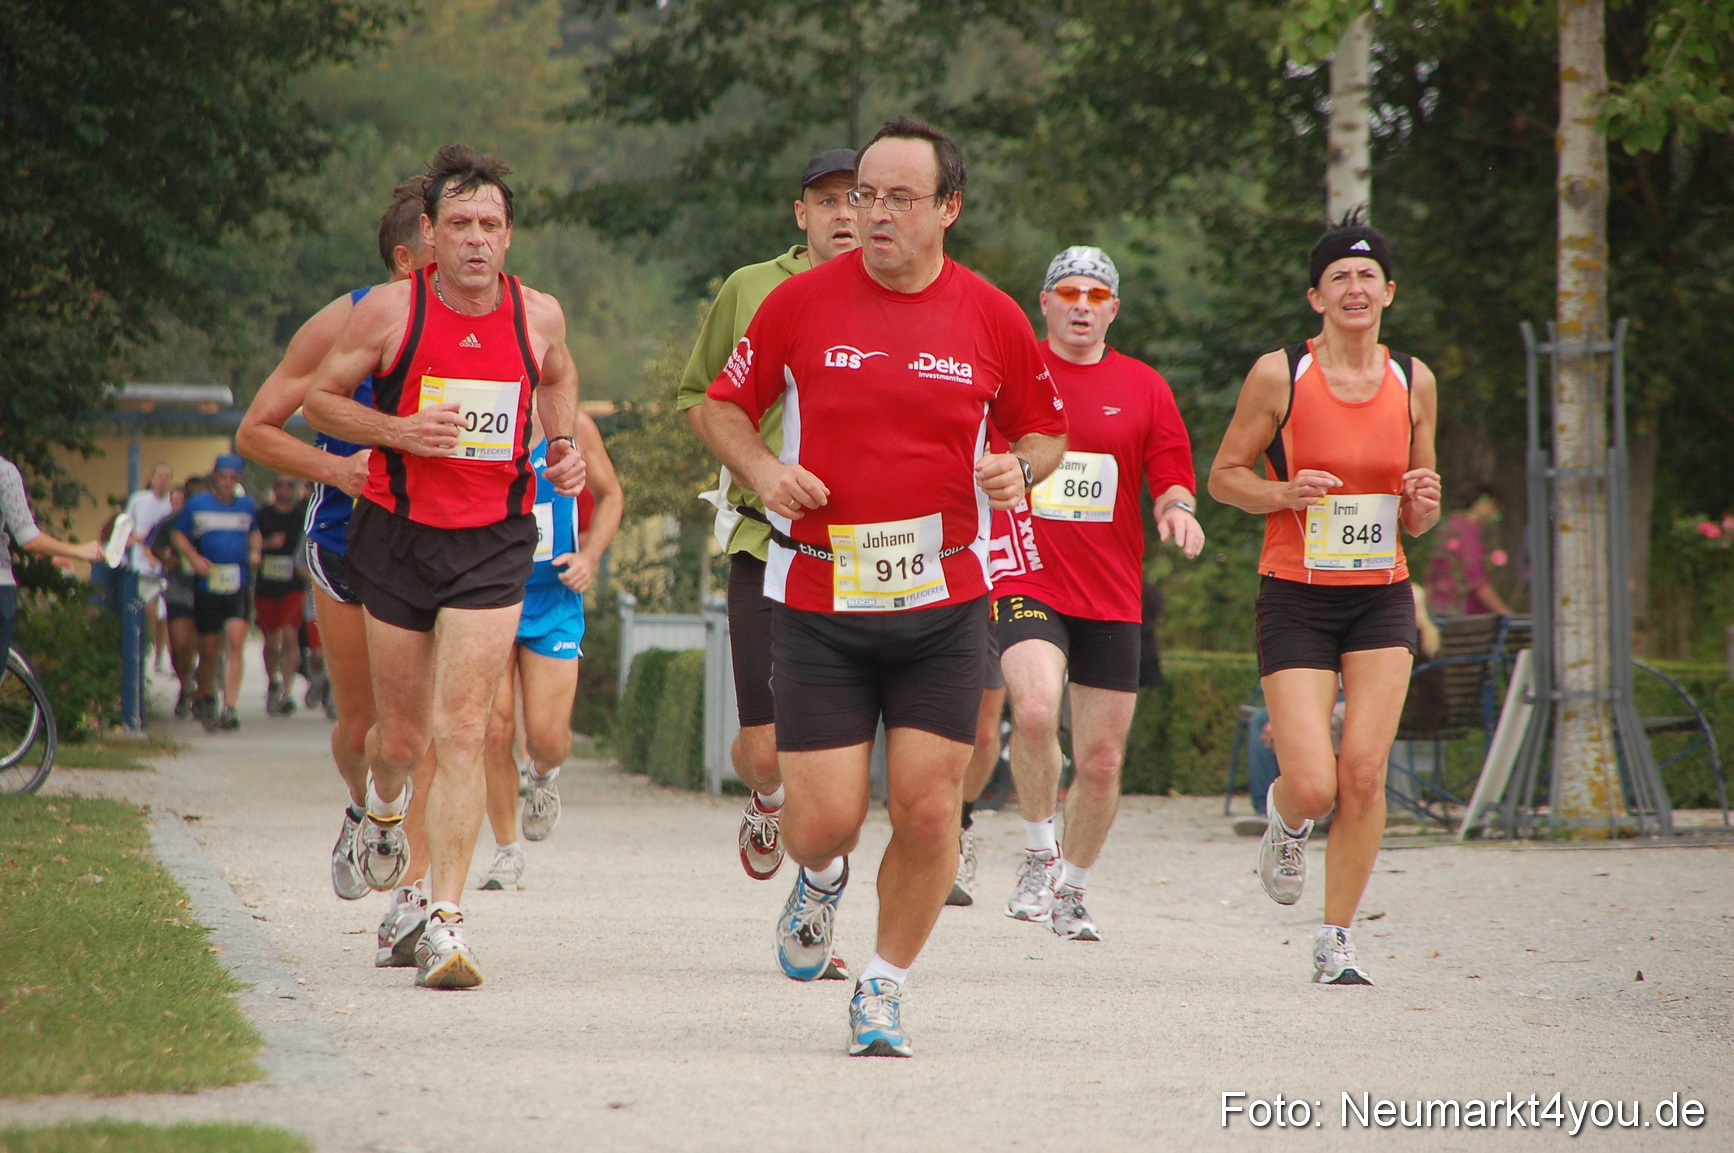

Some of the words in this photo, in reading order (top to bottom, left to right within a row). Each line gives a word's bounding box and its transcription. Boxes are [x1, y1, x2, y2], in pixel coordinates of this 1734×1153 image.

[824, 352, 862, 369] LBS
[919, 352, 973, 378] Deka
[918, 371, 973, 385] Investmentfonds
[463, 411, 509, 434] 020
[1064, 479, 1102, 498] 860
[1334, 501, 1358, 515] Irmi
[862, 531, 915, 549] Johann
[1342, 523, 1382, 545] 848
[1018, 517, 1044, 571] MAX
[876, 553, 925, 583] 918
[906, 585, 945, 602] PFLEIDERER
[1009, 609, 1048, 623] .com
